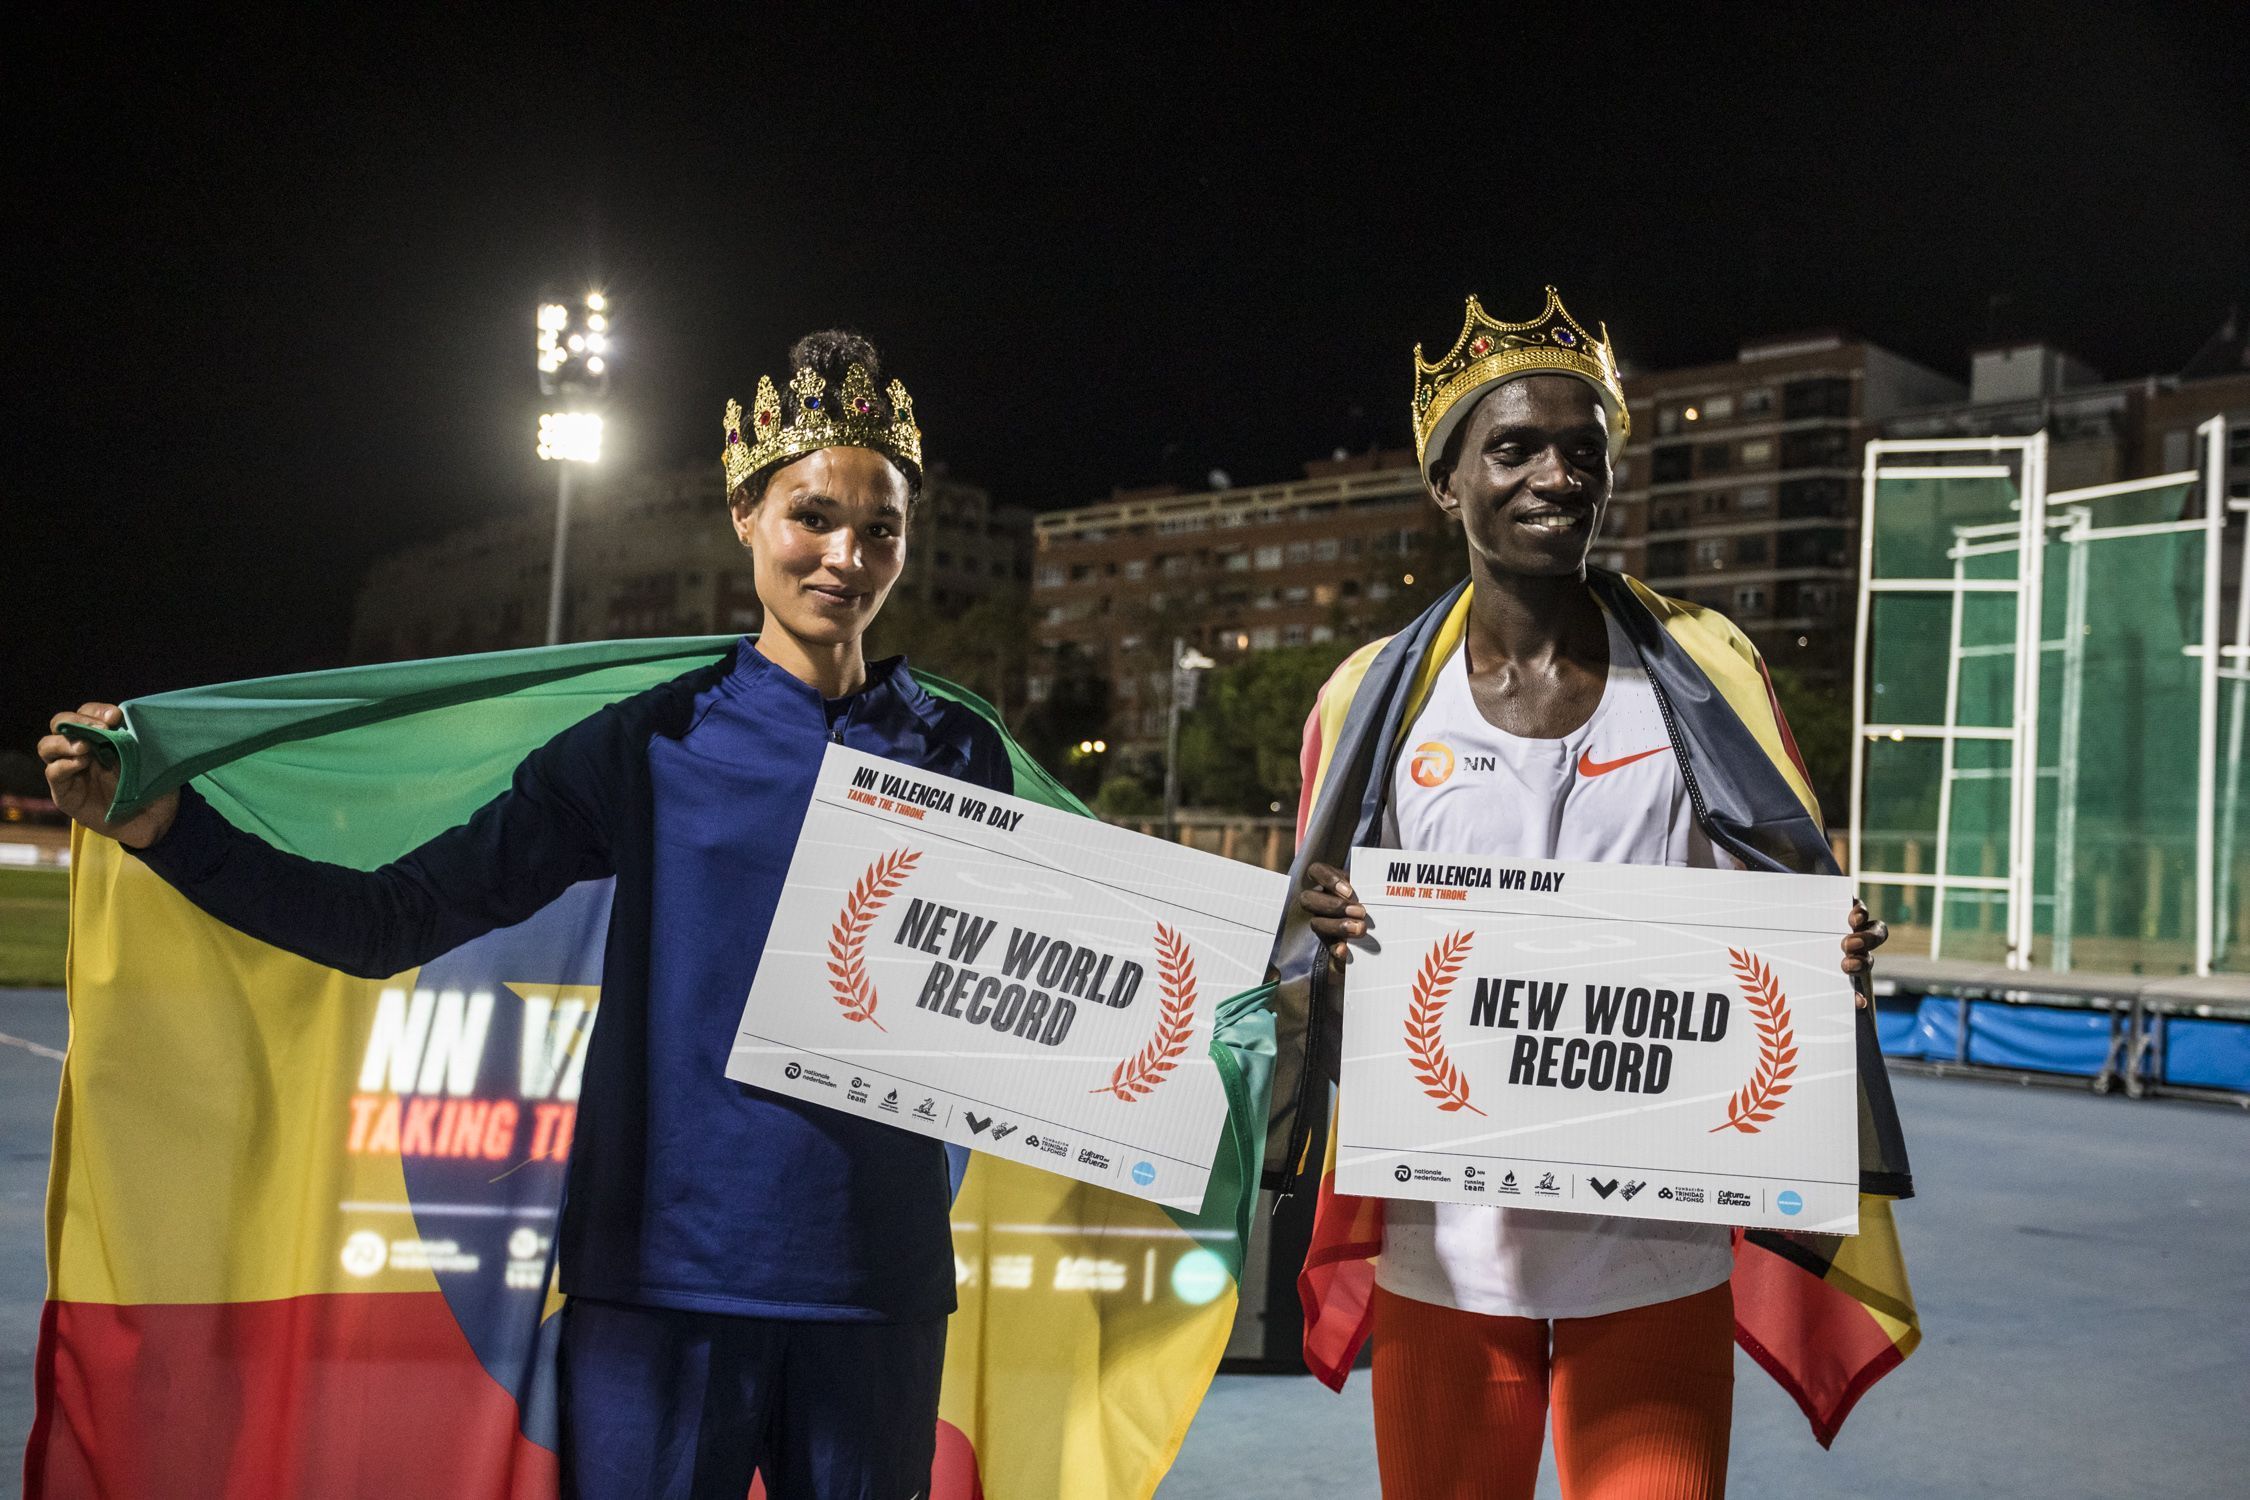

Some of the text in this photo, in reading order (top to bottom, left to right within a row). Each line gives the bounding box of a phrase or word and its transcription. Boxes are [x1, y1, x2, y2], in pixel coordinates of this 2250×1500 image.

[1464, 757, 1496, 772] NN
[847, 789, 927, 821] TAKING THE THRONE
[852, 766, 1024, 832] NN VALENCIA WR DAY
[1387, 862, 1565, 892] NN VALENCIA WR DAY
[1385, 885, 1469, 901] TAKING THE THRONE
[894, 897, 1144, 1009] NEW WORLD
[915, 961, 1077, 1046] RECORD
[1470, 977, 1730, 1042] NEW WORLD
[358, 988, 495, 1096] NN
[1508, 1034, 1673, 1094] RECORD
[802, 1074, 837, 1088] nederlanden
[804, 1068, 830, 1080] nationale
[847, 1093, 867, 1104] team
[348, 1096, 519, 1158] TAKING
[1039, 1146, 1067, 1158] ALFONSO
[1041, 1140, 1068, 1152] TRINIDAD
[1080, 1148, 1104, 1161] Cultura
[1077, 1155, 1108, 1170] Esfuerzo
[1413, 1174, 1452, 1183] nederlanden
[1414, 1168, 1442, 1176] nationale
[1464, 1179, 1485, 1187] running
[1464, 1184, 1485, 1192] team
[1675, 1191, 1704, 1199] TRINIDAD
[1718, 1190, 1744, 1199] Cultura
[1717, 1197, 1751, 1207] Esfuerzo
